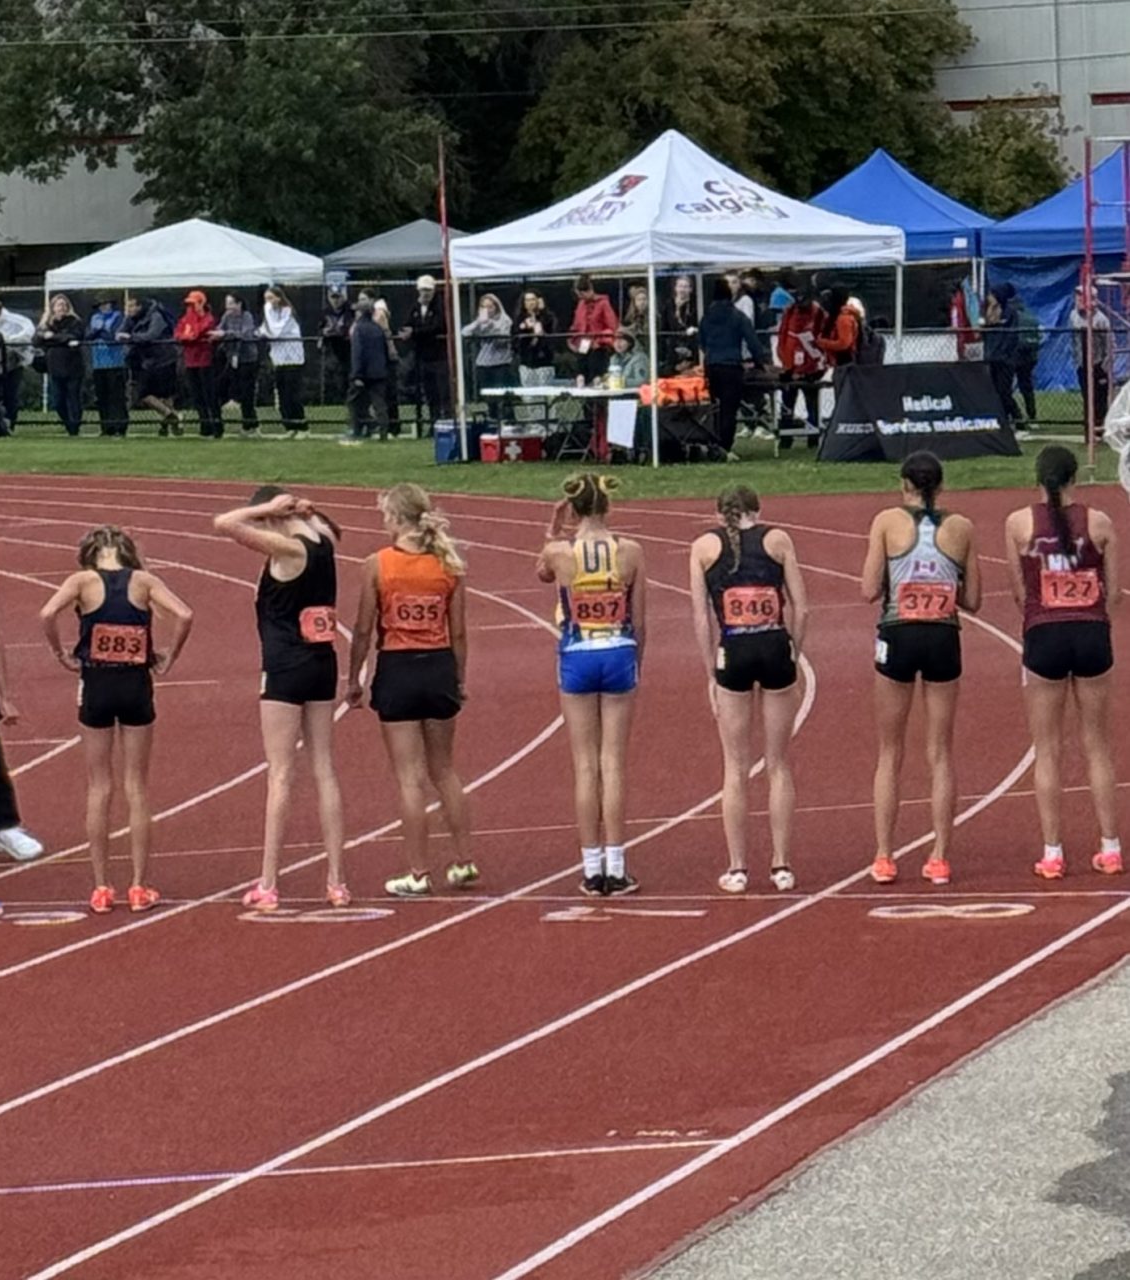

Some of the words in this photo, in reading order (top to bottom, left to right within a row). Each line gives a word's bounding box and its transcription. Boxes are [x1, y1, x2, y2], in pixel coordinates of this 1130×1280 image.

[902, 395, 953, 412] Medical
[1050, 580, 1093, 599] 127
[576, 601, 620, 620] 897
[730, 598, 774, 617] 846
[904, 592, 949, 612] 377
[397, 603, 439, 621] 635
[97, 634, 141, 655] 883
